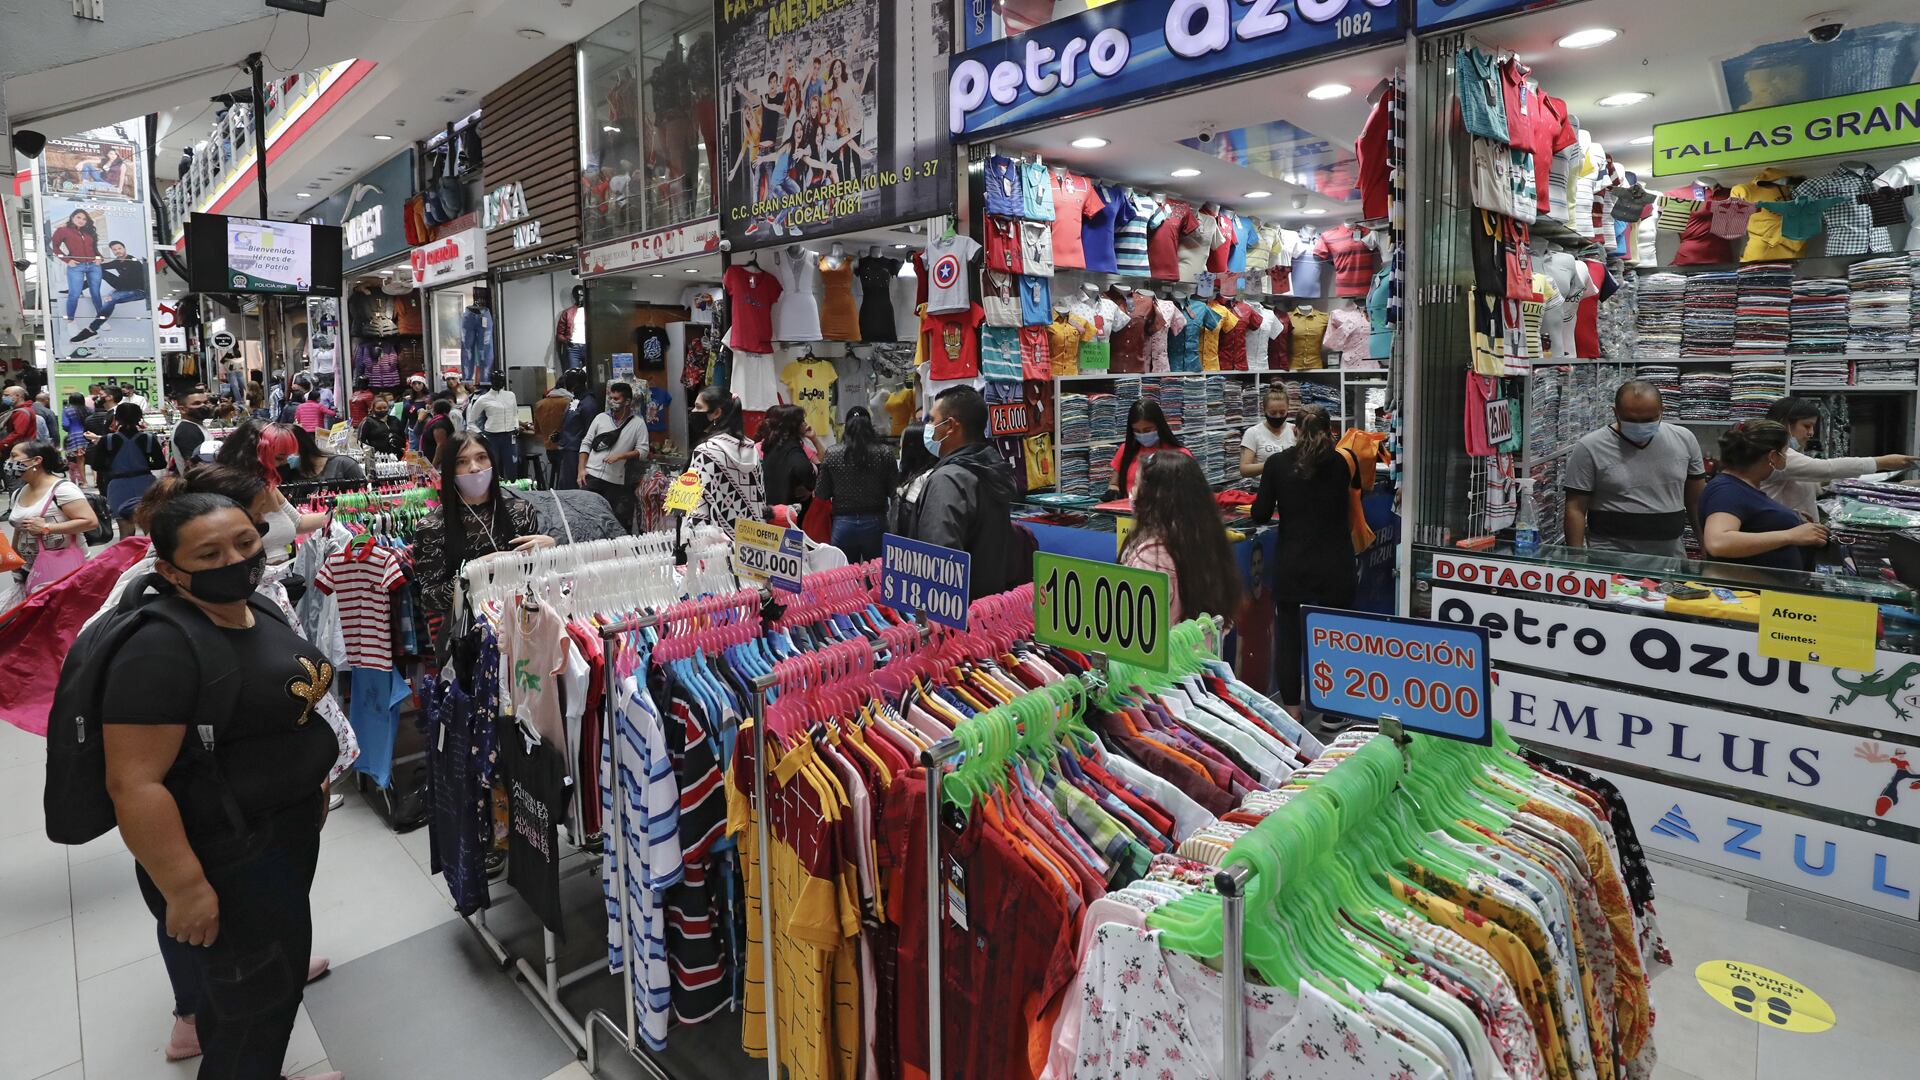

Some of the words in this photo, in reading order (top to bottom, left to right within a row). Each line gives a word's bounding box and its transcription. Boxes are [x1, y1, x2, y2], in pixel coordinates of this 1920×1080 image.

[1335, 12, 1372, 40] 1082
[1659, 125, 1793, 160] TALLAS
[731, 207, 750, 221] C.C.
[751, 197, 779, 216] GRAN
[782, 191, 804, 209] SAN
[805, 179, 862, 204] CARRERA
[863, 174, 877, 192] 10
[880, 170, 901, 188] No.
[903, 166, 913, 182] 9
[923, 159, 940, 177] 37
[787, 205, 829, 227] LOCAL
[833, 196, 863, 217] 1081
[247, 245, 296, 256] Bienvenidos
[282, 256, 292, 264] de
[265, 264, 289, 272] Patria
[738, 524, 756, 534] GRAN
[756, 529, 779, 542] OFERTA
[739, 545, 798, 578] $20.000
[885, 544, 965, 590] PROMOCIÓN
[884, 573, 894, 601] $
[1436, 559, 1608, 600] DOTACIÓN
[1771, 607, 1818, 623] Aforo:
[1313, 627, 1475, 670] PROMOCIÓN
[1770, 631, 1817, 646] Clientes:
[1313, 660, 1335, 698] $
[1344, 667, 1480, 719] 20.000
[1508, 690, 1822, 788] EMPLUS
[1725, 962, 1805, 994] Distancia
[1730, 972, 1752, 984] de
[1755, 981, 1798, 1000] vida.
